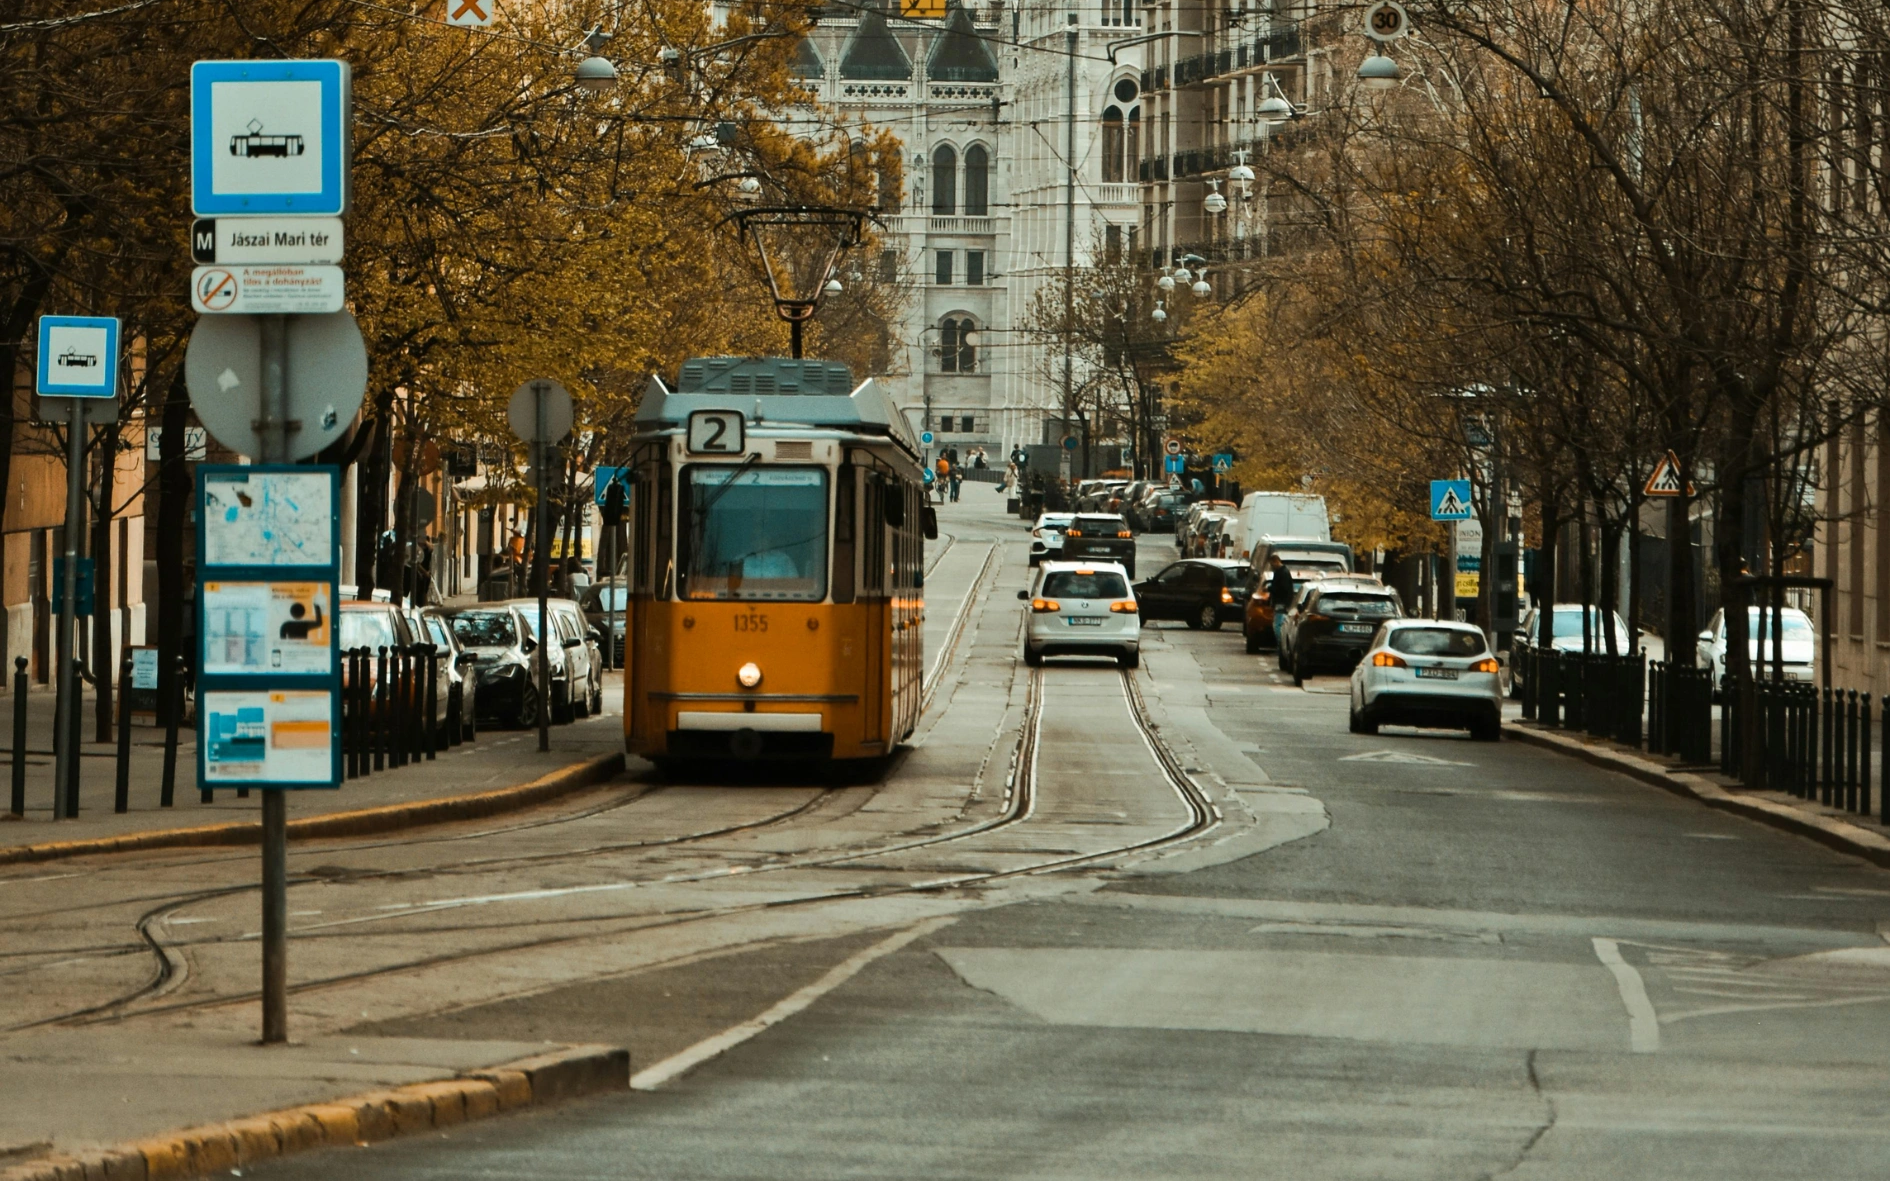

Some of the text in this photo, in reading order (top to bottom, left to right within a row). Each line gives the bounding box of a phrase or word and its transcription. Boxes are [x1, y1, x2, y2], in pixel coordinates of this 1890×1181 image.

[1375, 12, 1398, 29] 30
[197, 232, 213, 250] M
[230, 231, 329, 247] Jászai Mari tér
[703, 416, 727, 450] 2
[751, 472, 760, 485] 2
[733, 614, 769, 632] 1355
